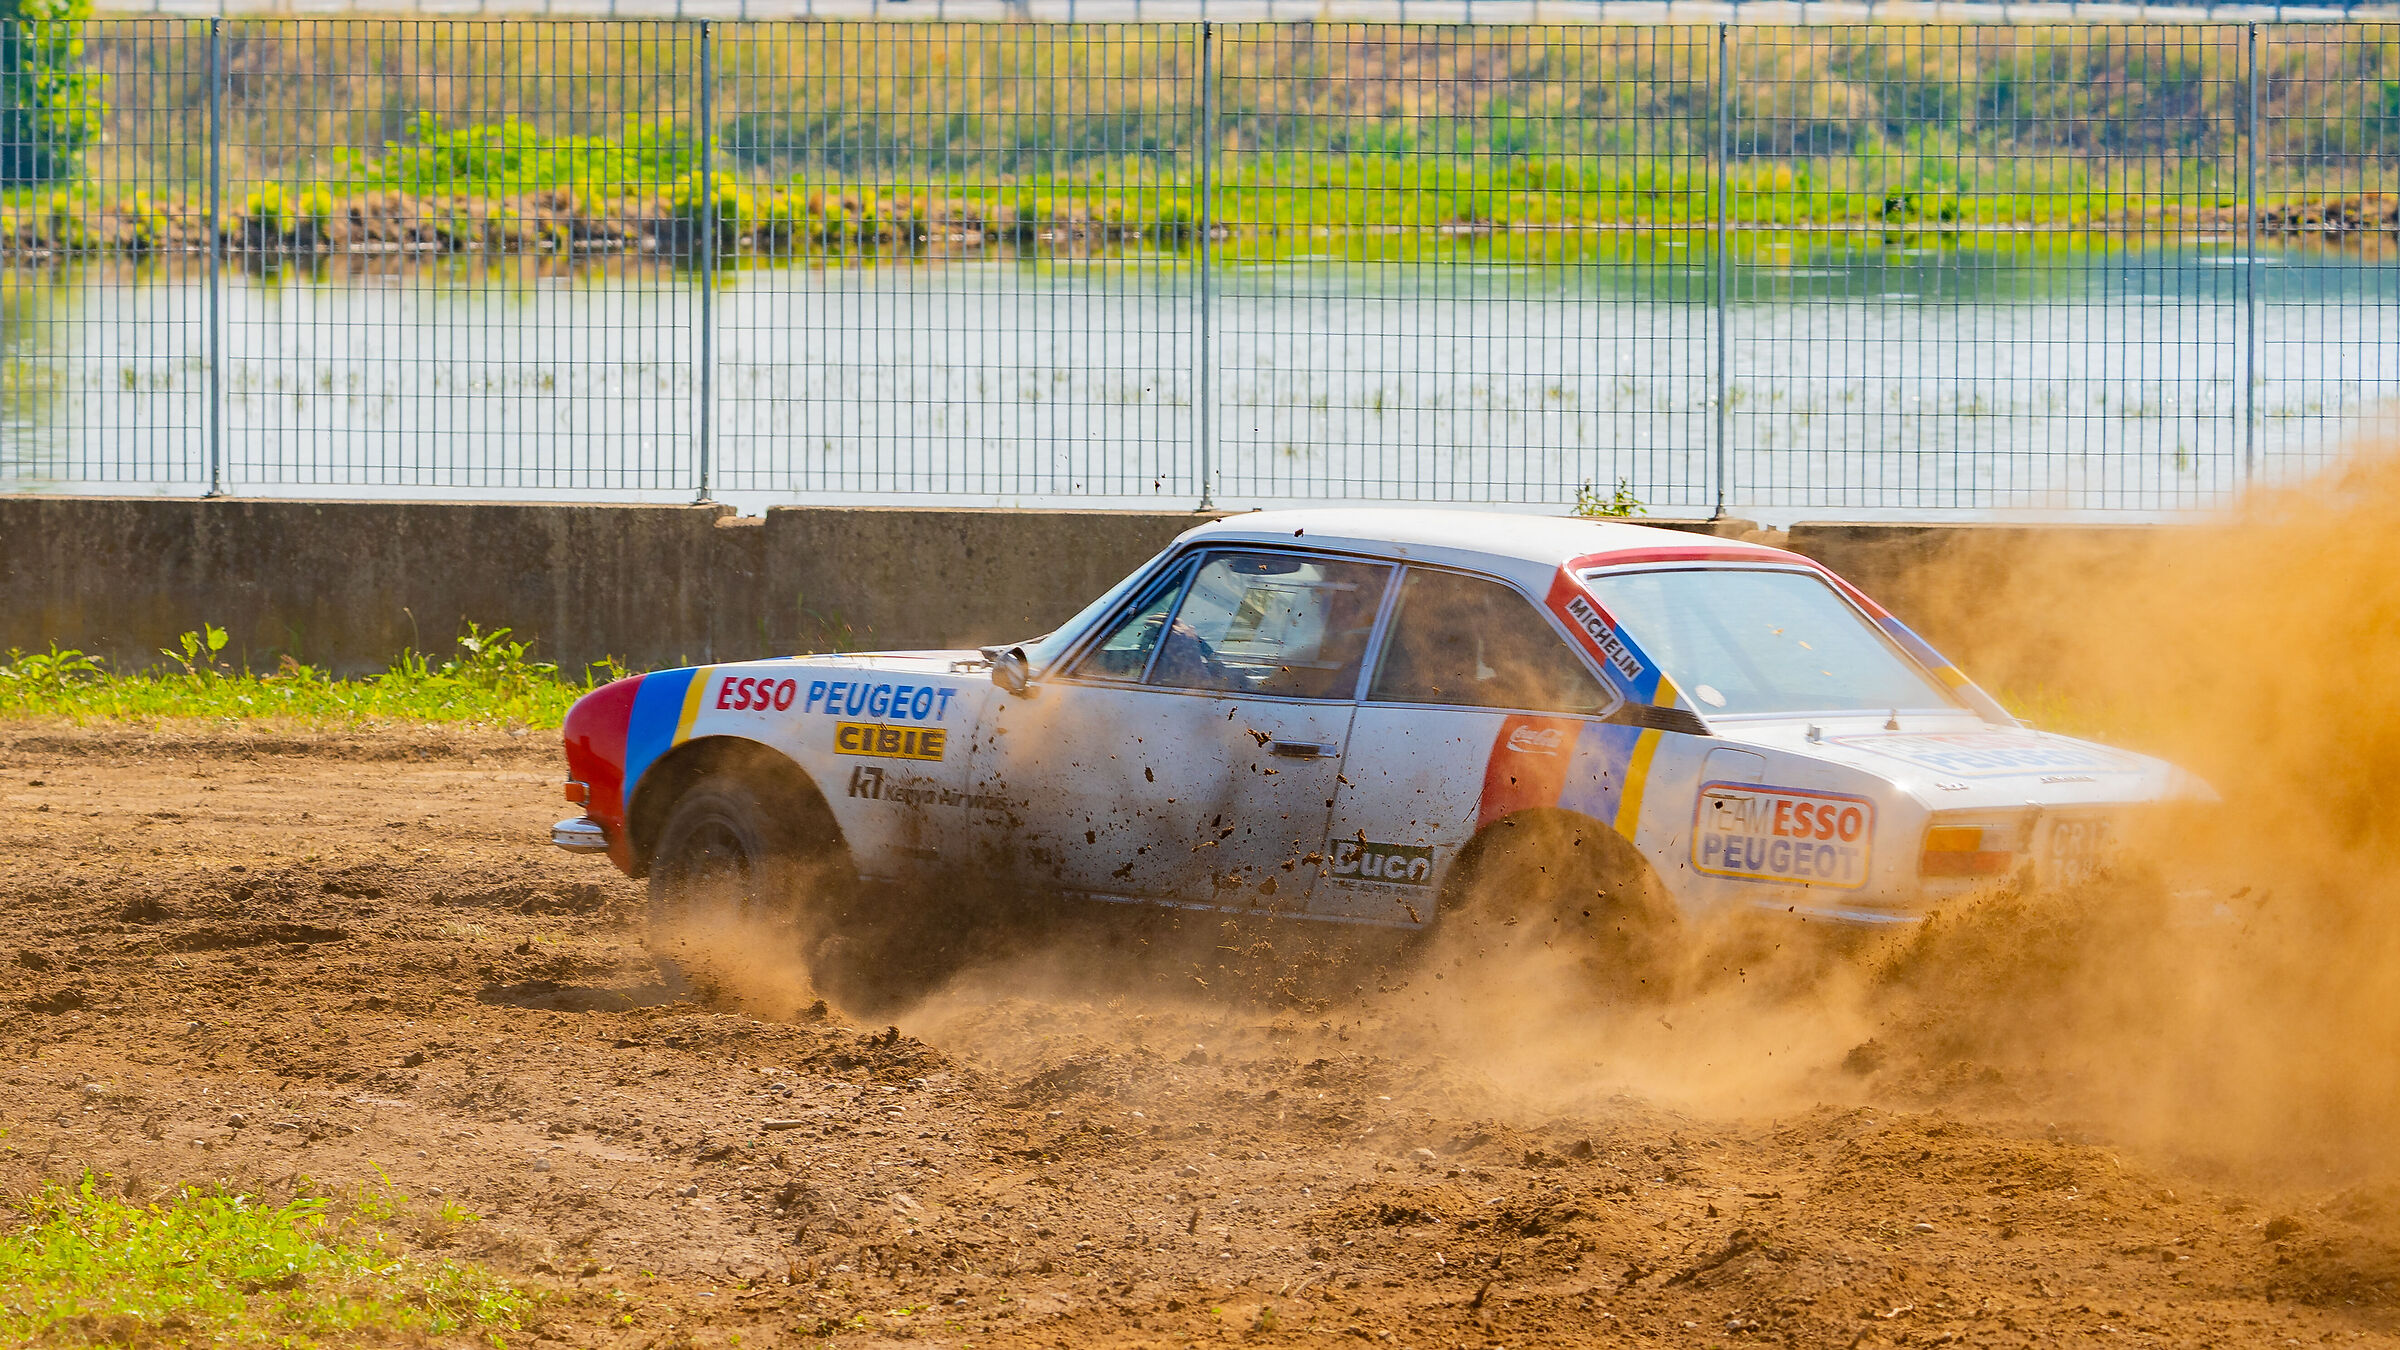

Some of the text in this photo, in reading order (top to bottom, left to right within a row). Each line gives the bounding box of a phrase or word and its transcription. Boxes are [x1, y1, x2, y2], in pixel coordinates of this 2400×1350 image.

[1570, 598, 1640, 678] MICHELIN
[716, 676, 957, 721] ESSO PEUGEOT
[839, 726, 945, 757] CIBIE
[1703, 794, 1863, 842] TEAM ESSO
[1334, 842, 1431, 881] Duco
[1703, 832, 1859, 880] PEUGEOT
